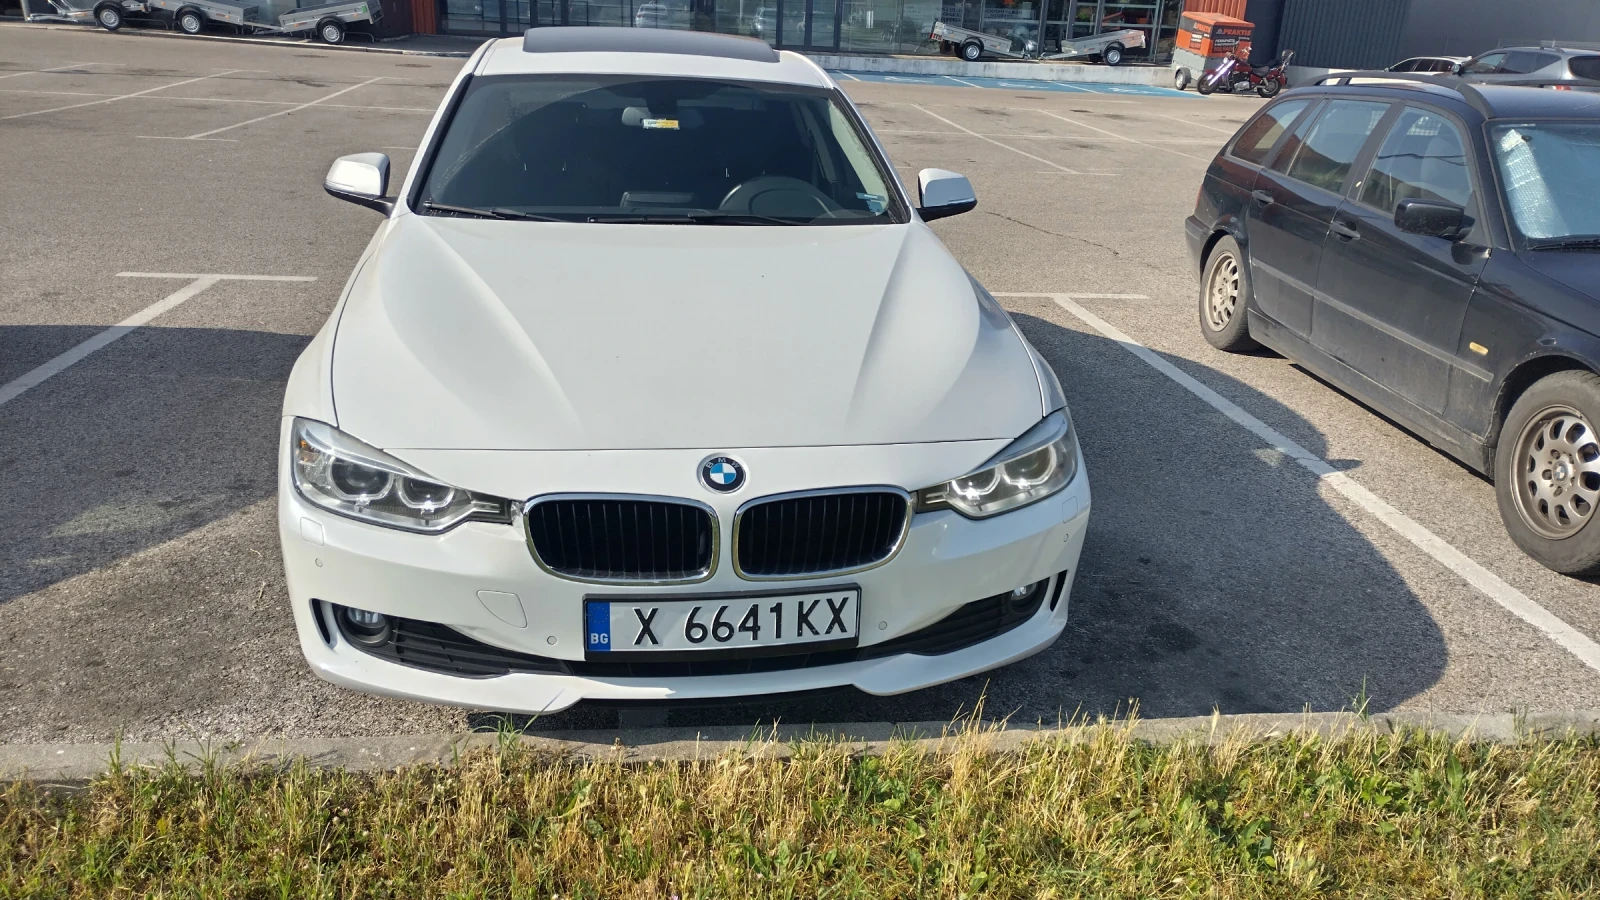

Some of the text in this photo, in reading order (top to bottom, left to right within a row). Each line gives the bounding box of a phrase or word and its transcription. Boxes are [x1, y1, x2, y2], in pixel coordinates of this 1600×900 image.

[1223, 28, 1252, 36] PRAKTIS
[705, 457, 741, 469] BMW
[633, 607, 659, 645] X
[590, 632, 609, 645] BG
